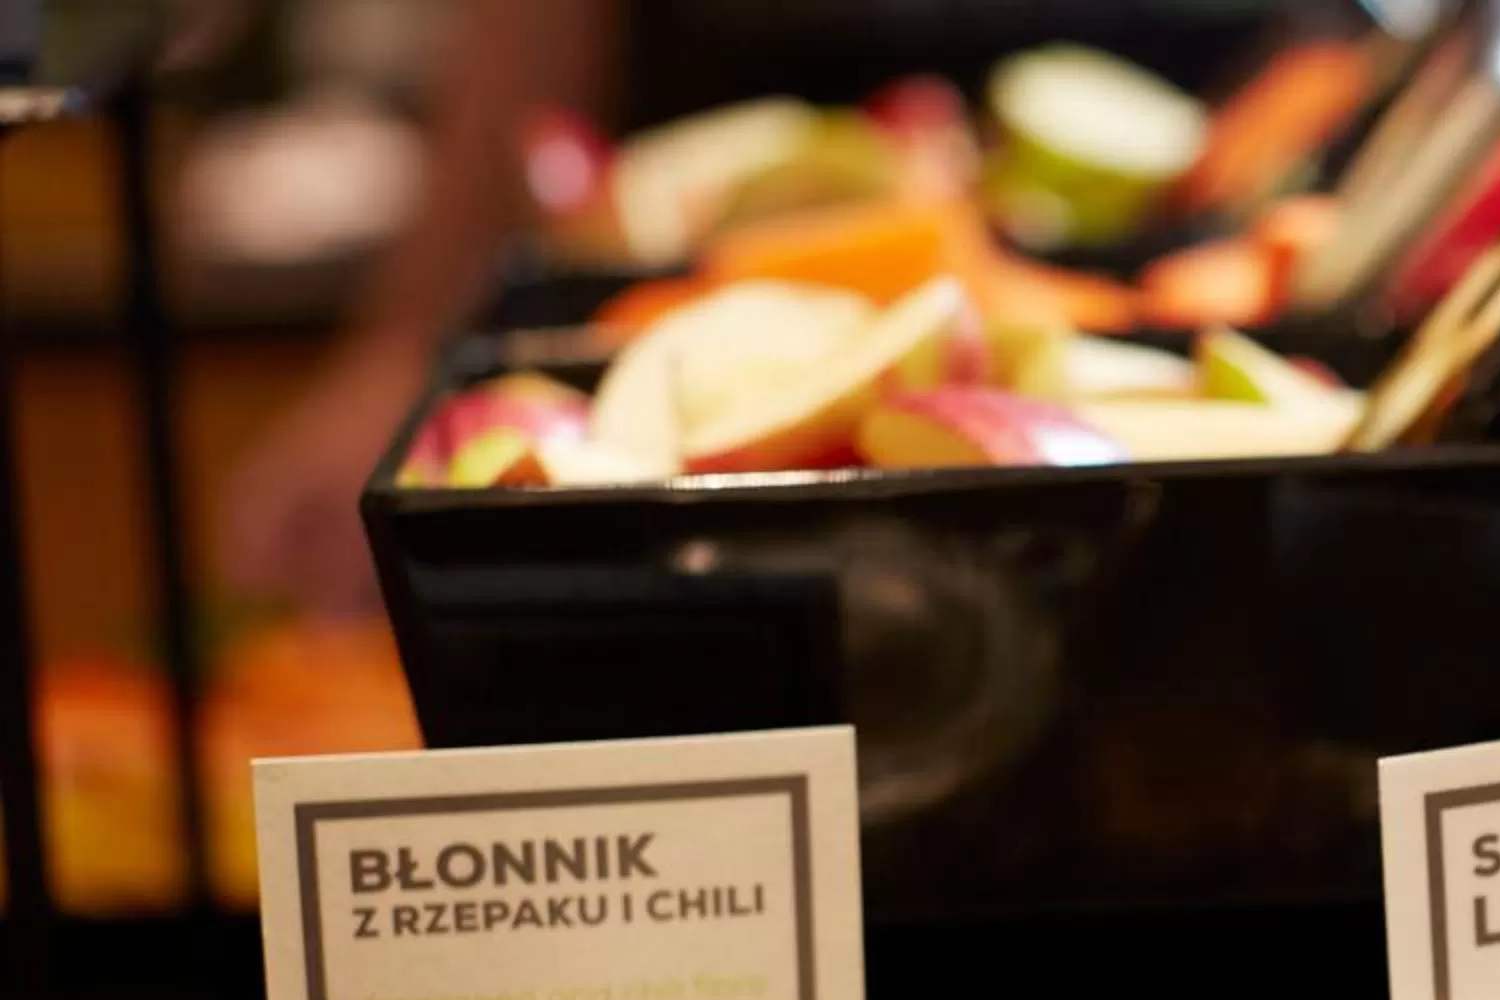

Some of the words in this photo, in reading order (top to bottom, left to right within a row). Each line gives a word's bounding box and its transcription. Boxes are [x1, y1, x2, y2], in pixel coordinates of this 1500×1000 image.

[348, 832, 657, 895] BŁONNIK
[351, 907, 380, 939] Z
[391, 895, 607, 937] RZEPAKU
[622, 894, 633, 923] I
[646, 884, 765, 921] CHILI
